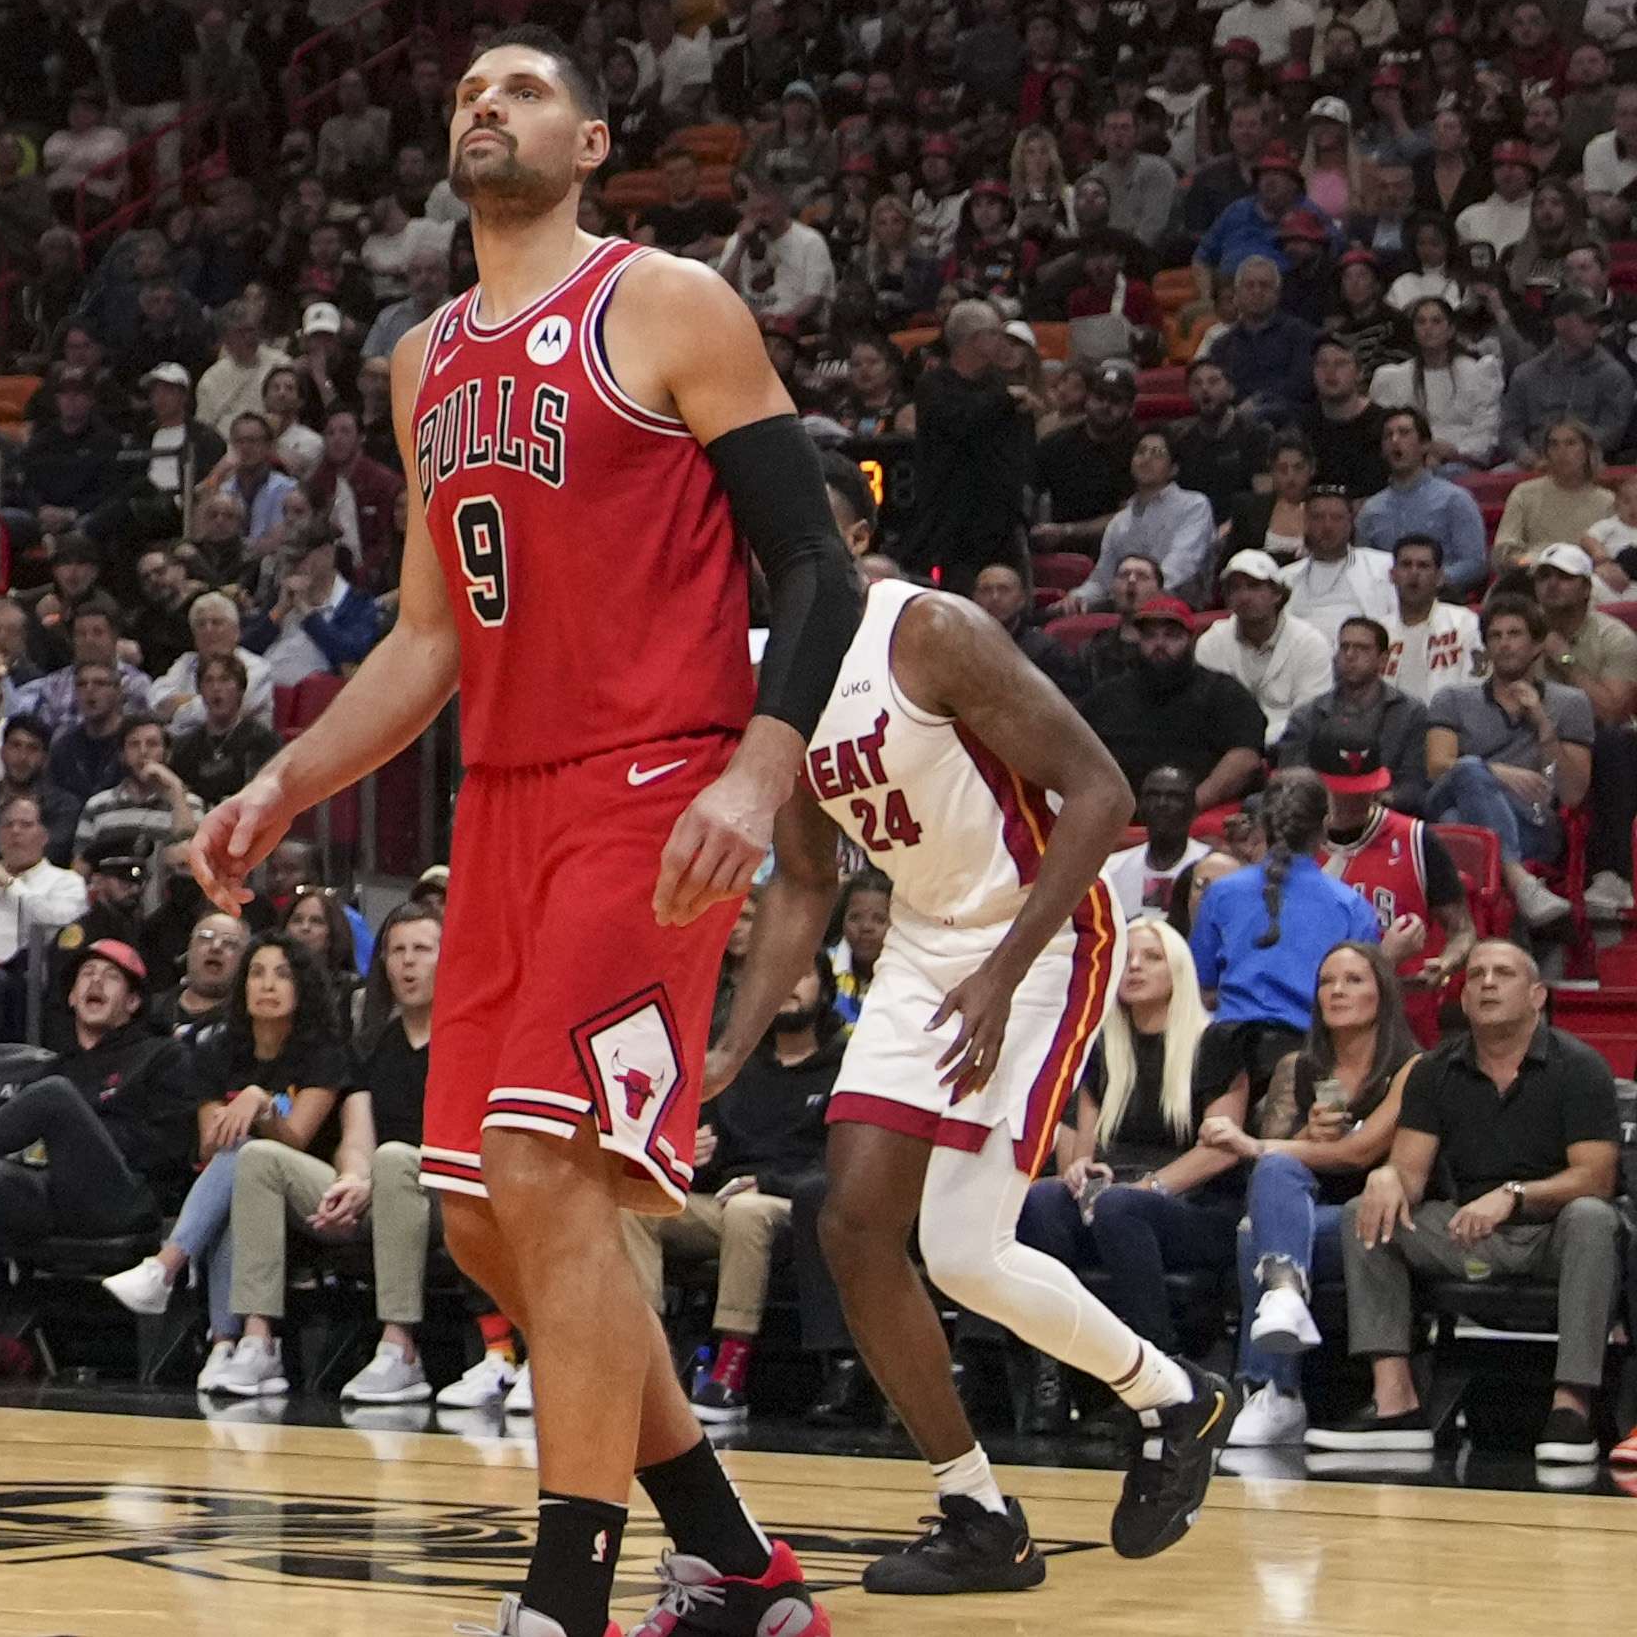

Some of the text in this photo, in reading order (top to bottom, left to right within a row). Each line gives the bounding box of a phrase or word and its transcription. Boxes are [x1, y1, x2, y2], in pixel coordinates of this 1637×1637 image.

[443, 316, 458, 342] 6
[415, 376, 569, 516] BULLS
[453, 494, 508, 628] 9
[841, 680, 872, 698] UKG
[850, 789, 923, 852] 24
